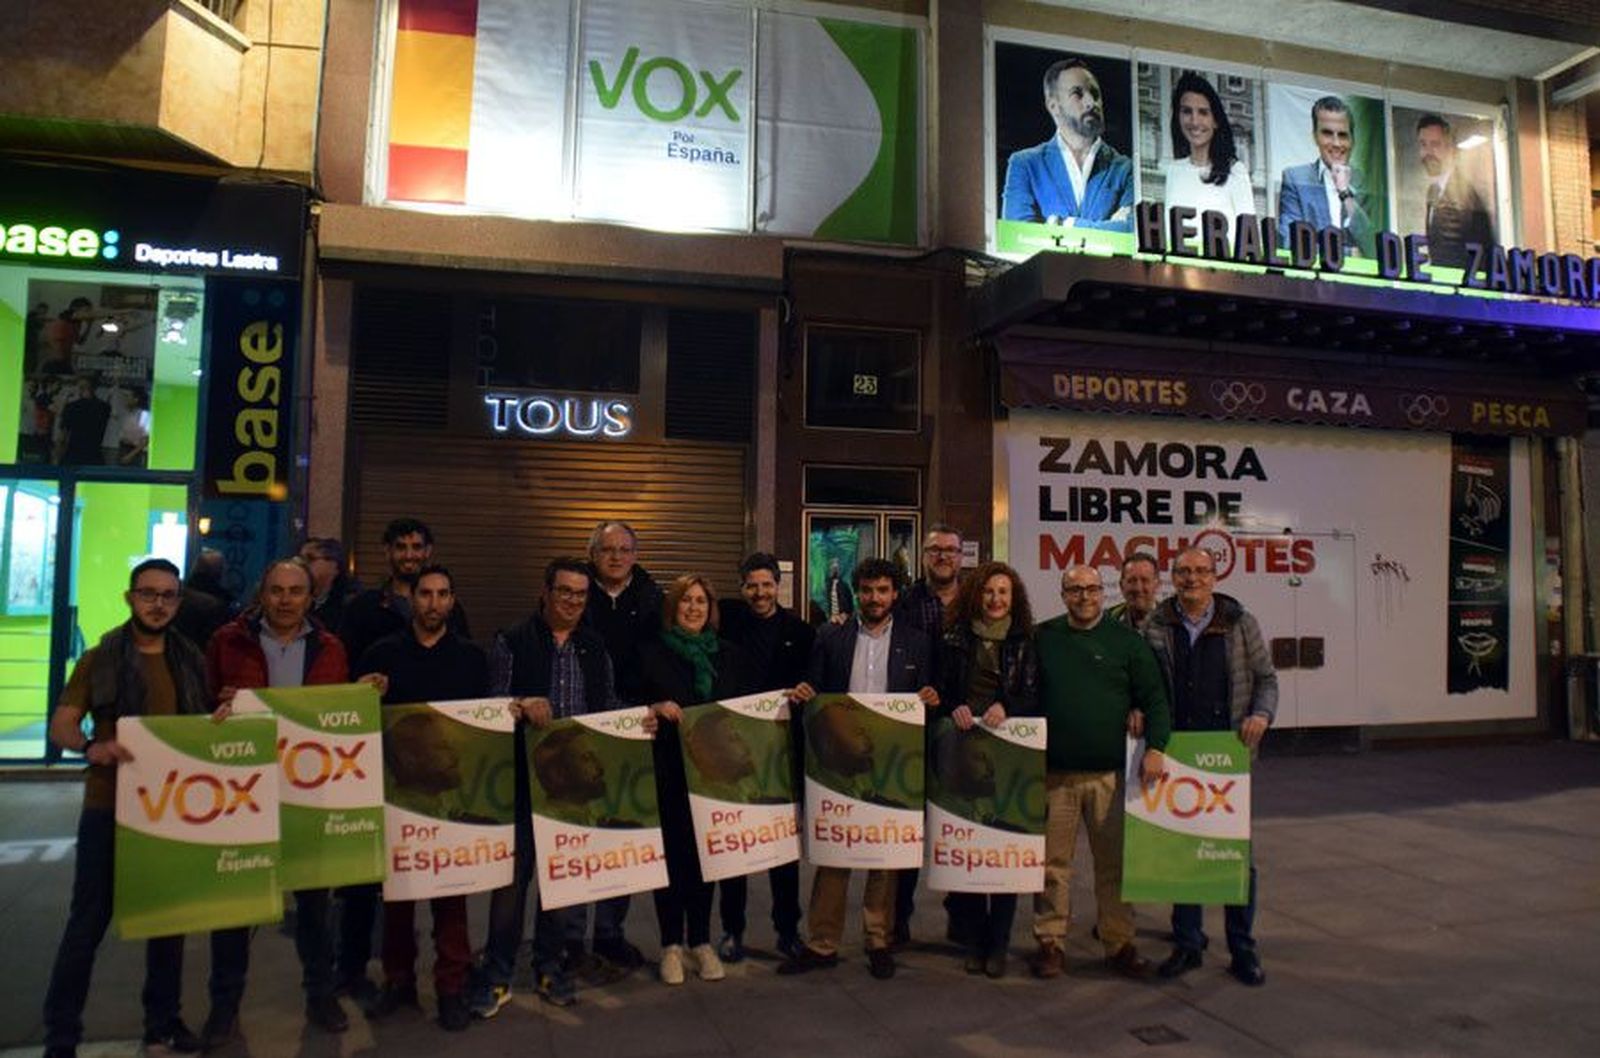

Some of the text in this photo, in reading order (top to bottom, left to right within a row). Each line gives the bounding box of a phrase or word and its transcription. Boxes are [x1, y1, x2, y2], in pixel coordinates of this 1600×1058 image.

[589, 47, 742, 122] VOX
[673, 131, 695, 143] Por
[668, 142, 740, 165] España.
[1137, 201, 1345, 273] HERALDO
[1376, 231, 1433, 284] DE
[135, 243, 278, 271] Deportes Lastra
[1053, 373, 1551, 428] DEPORTES CAZA PESCA
[485, 394, 631, 436] TOUS
[1039, 437, 1267, 481] ZAMORA
[1039, 486, 1242, 526] LIBRE DE
[318, 711, 361, 727] VOTA
[472, 703, 503, 721] VOX
[1009, 723, 1038, 739] VOX
[210, 741, 256, 759] VOTA
[1195, 753, 1232, 767] VOTA
[137, 770, 262, 825] VOX
[821, 800, 854, 816] Por
[711, 810, 742, 826] Por
[402, 824, 440, 841] Por
[555, 834, 589, 851] Por
[815, 817, 924, 848] España.
[941, 824, 974, 841] Por
[547, 841, 665, 880] España.
[934, 841, 1045, 872] España.
